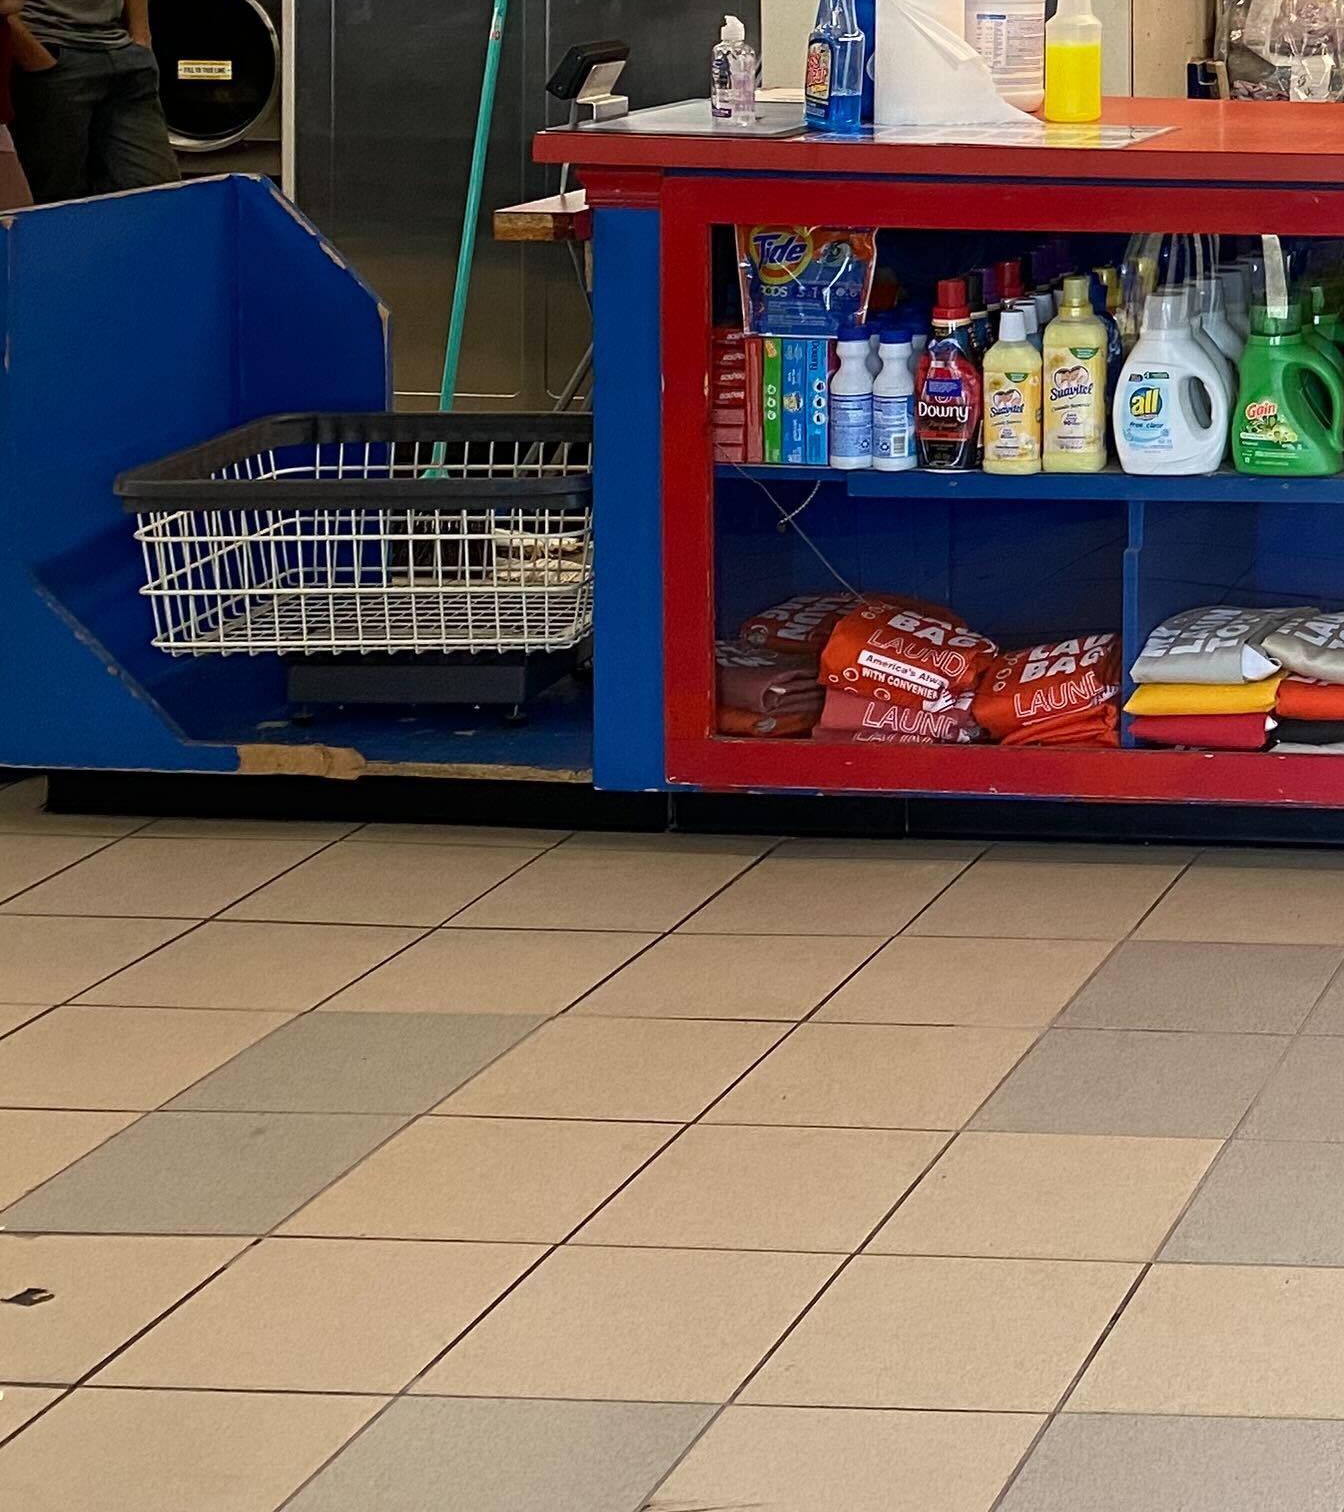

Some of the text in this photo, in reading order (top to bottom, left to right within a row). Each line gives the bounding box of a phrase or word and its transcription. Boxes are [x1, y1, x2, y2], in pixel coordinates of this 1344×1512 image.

[753, 232, 807, 266] Tide
[1050, 383, 1093, 401] Suavitel
[918, 401, 969, 423] Downy
[990, 403, 1024, 418] Suavitel
[1132, 389, 1160, 416] all
[1246, 403, 1277, 419] Gain
[861, 667, 886, 683] WITH
[866, 654, 916, 677] America's
